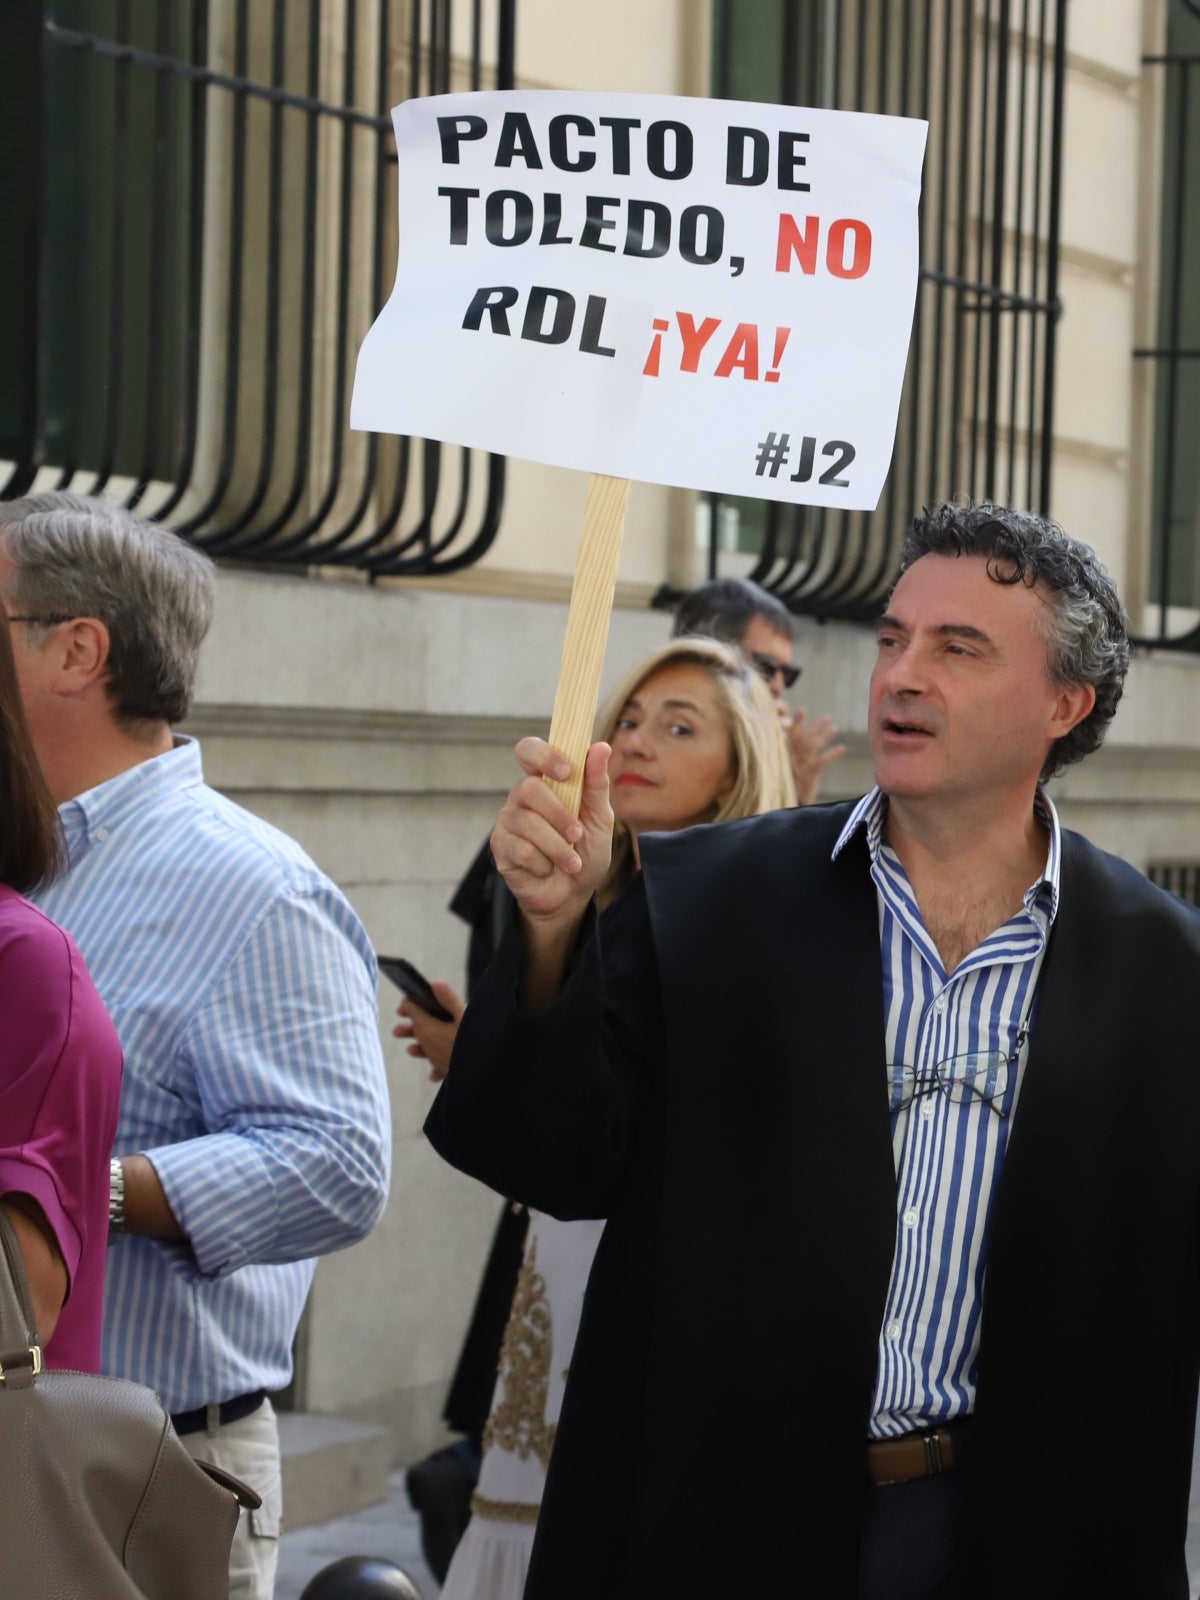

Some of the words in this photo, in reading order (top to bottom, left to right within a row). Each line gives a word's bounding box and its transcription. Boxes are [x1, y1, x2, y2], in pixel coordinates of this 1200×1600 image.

[437, 112, 693, 180] PACTO
[725, 126, 811, 192] DE
[438, 186, 745, 277] TOLEDO,
[775, 213, 873, 280] NO
[461, 286, 616, 357] RDL
[642, 311, 791, 383] ¡YA!
[755, 432, 857, 487] #J2
